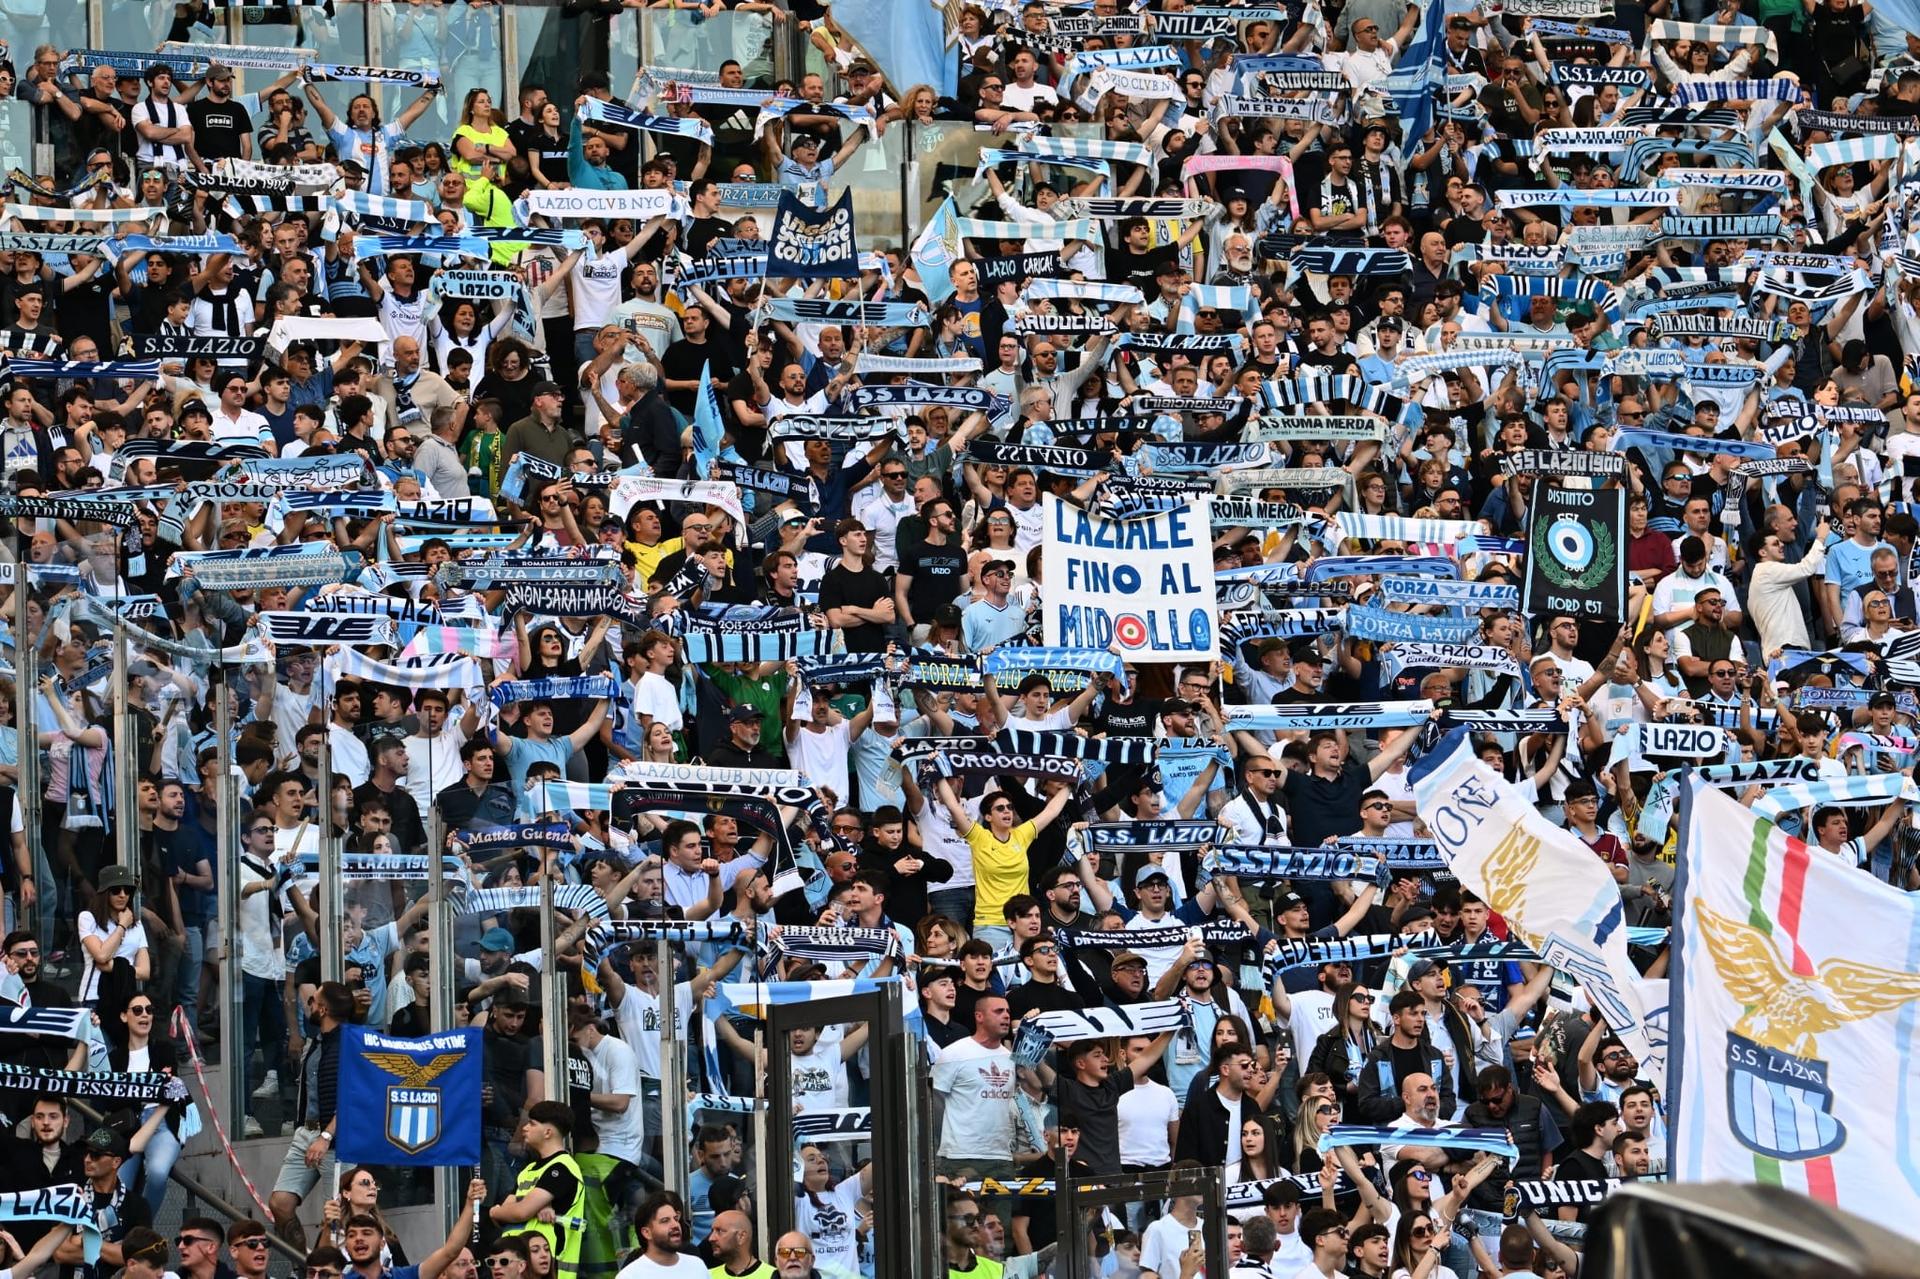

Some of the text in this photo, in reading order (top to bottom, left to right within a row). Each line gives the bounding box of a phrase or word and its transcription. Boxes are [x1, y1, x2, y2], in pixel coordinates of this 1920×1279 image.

[1229, 8, 1271, 19] LAZIO
[1055, 16, 1140, 31] MISTER ENRICH
[1078, 47, 1178, 68] S.S. LAZIO
[335, 66, 422, 83] S.S. LAZIO
[1559, 66, 1646, 85] S.S.LAZIO
[1239, 103, 1300, 115] MERDA
[208, 117, 231, 126] oasis
[1817, 115, 1891, 131] IRRIDUCIBILI
[199, 174, 287, 192] SS LAZIO 1900
[1682, 171, 1781, 188] S.S. LAZIO
[537, 191, 664, 210] LAZIO CLVB NYC
[720, 187, 780, 201] ORZA LAZI
[1510, 190, 1670, 203] FORZA LAZIO
[1663, 215, 1781, 235] AVANTI LAZIO
[151, 235, 218, 247] OLIMPIA
[986, 254, 1053, 278] LAZIO CARICA!
[1580, 252, 1625, 268] LAZIO
[449, 271, 484, 282] AQUILA
[460, 284, 504, 297] LAZIO
[145, 338, 255, 355] S.S. LAZIO
[1462, 336, 1513, 350] FORZA
[1709, 367, 1753, 381] LAZIO
[858, 386, 983, 404] S.S. LAZIO
[1326, 417, 1375, 431] MERDA
[1764, 414, 1816, 442] AZIO
[1653, 435, 1746, 454] LAZIO
[5, 456, 37, 468] adida
[1157, 442, 1264, 465] S.S.LAZIO
[1515, 453, 1623, 472] SS LAZIO 1900
[570, 471, 613, 484] AZIO
[736, 465, 752, 485] SS
[755, 468, 789, 493] LAZIO
[1548, 489, 1594, 505] DISTINTO
[54, 500, 132, 514] CREDER
[399, 499, 471, 521] LAZIO
[1212, 502, 1303, 518] ROMA MERDA
[1057, 500, 1193, 550] LAZIALE
[465, 568, 596, 579] FORZA LAZIO
[1068, 558, 1201, 595] FINO AL
[1384, 579, 1439, 596] FORZA
[1547, 596, 1602, 614] NORD EST
[1060, 604, 1211, 651] MIDOLLO
[1351, 613, 1413, 639] FORZA
[1395, 643, 1482, 658] S.S. LAZIO
[998, 649, 1116, 671] S.S. LAZIO
[919, 661, 970, 687] FORZA
[1288, 717, 1373, 728] S.S.LAZIO
[902, 739, 976, 754] LAZIO
[1655, 730, 1714, 751] LAZIO
[951, 754, 1080, 776] ORGOGLIOSI
[1732, 760, 1818, 782] LAZIO
[638, 764, 786, 785] LAZIO CLUB NYC
[469, 829, 518, 844] Mattéo
[1096, 829, 1212, 844] S.S. LAZIO
[358, 860, 430, 871] LAZIO 190
[1223, 850, 1353, 877] S.S.LAZIO
[364, 1034, 379, 1046] HIC
[435, 1034, 466, 1049] OPTIME
[1731, 1044, 1821, 1084] S.S. LAZIO
[76, 1080, 160, 1099] ESSERE!
[1518, 1179, 1624, 1204] UNICA
